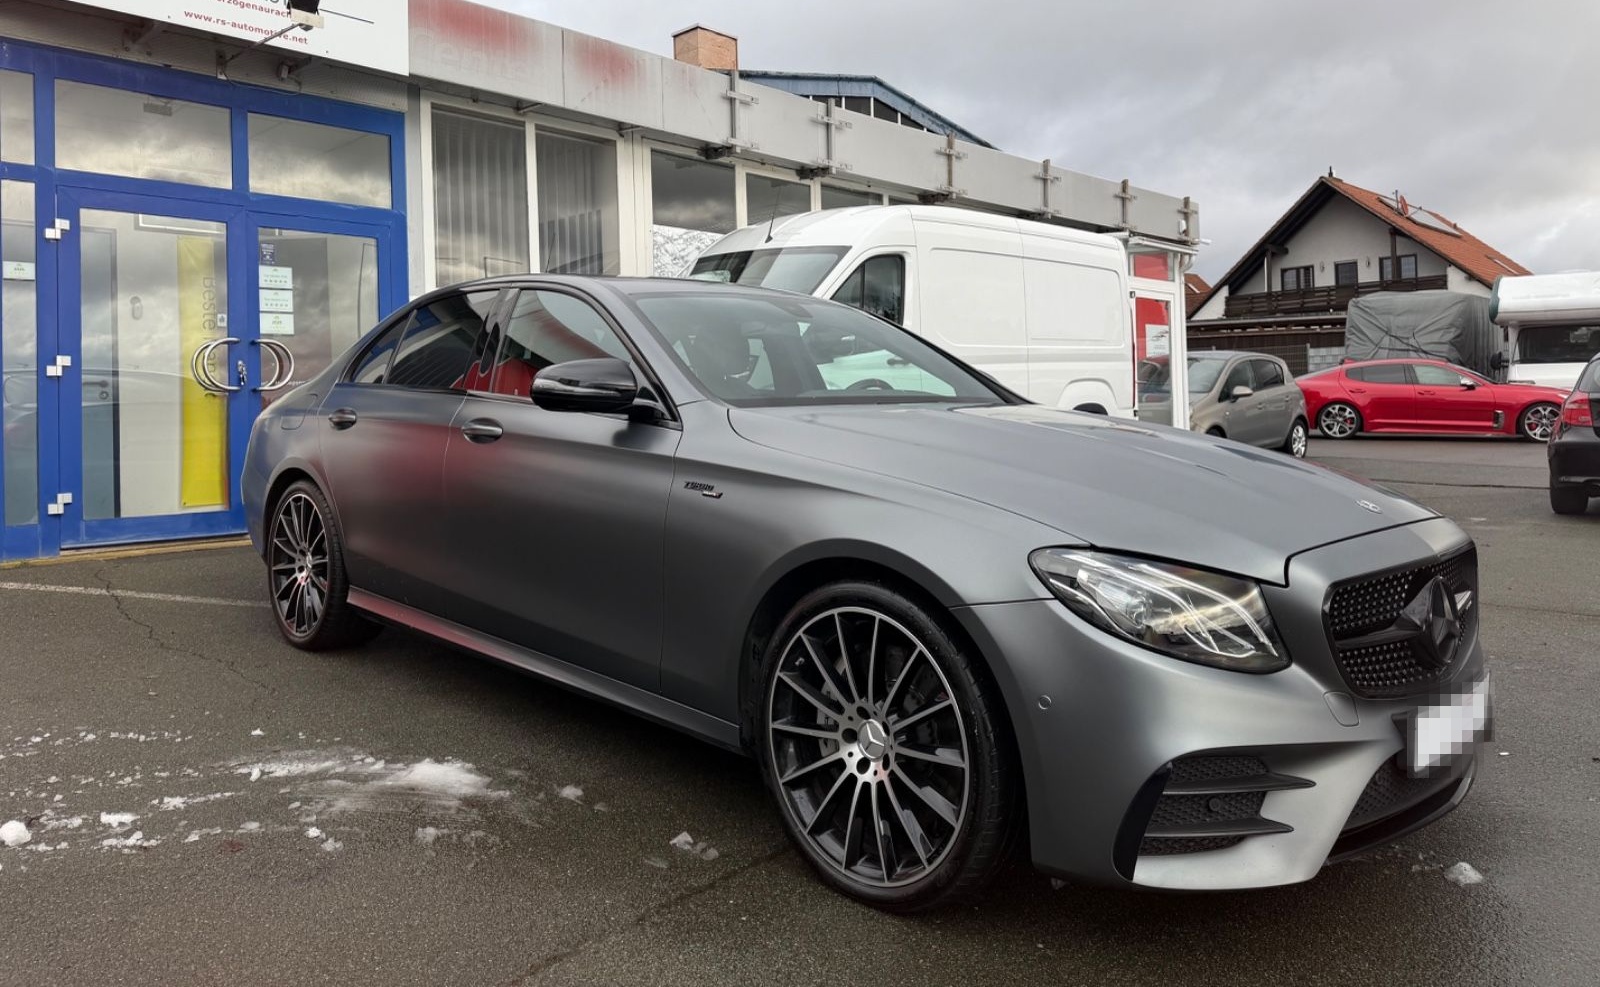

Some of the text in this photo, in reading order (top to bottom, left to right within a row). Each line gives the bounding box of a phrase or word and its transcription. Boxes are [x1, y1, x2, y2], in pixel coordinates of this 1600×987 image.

[216, 0, 291, 18] rzogenaurach
[184, 10, 308, 45] www.rs-automote.net
[202, 277, 217, 330] Beste
